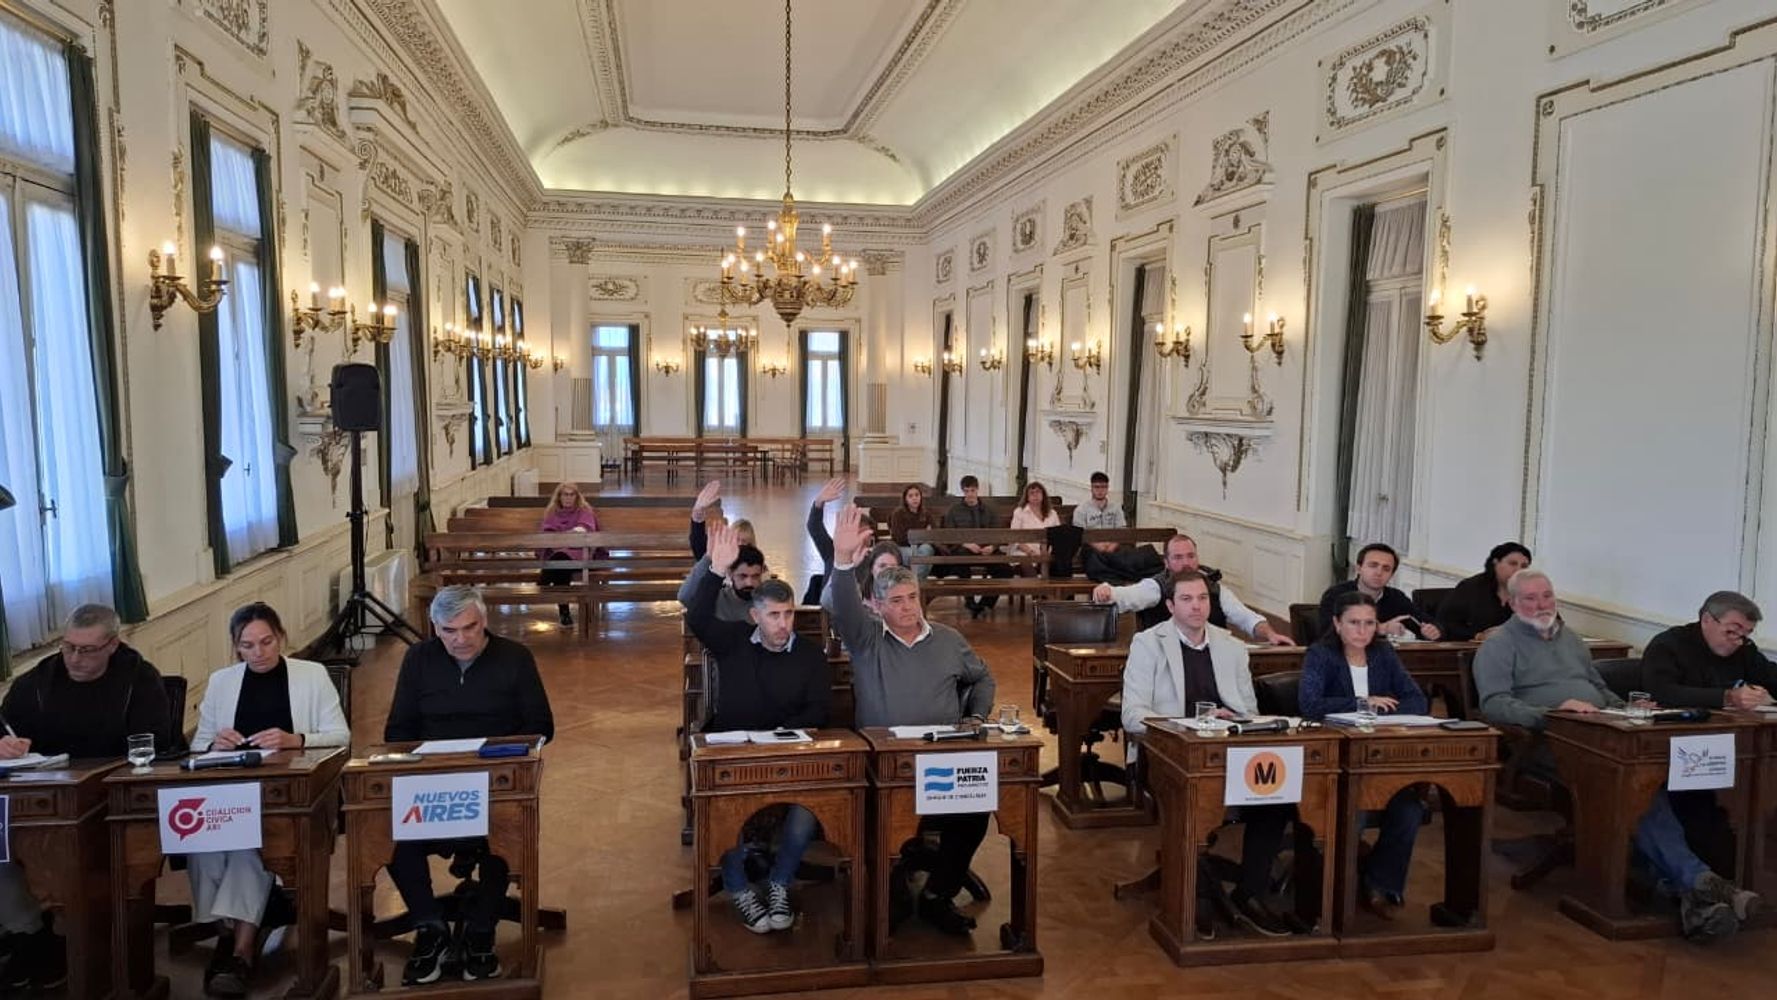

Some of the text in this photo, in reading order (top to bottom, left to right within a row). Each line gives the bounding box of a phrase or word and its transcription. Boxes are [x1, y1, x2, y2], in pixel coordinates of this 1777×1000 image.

[956, 767, 989, 775] FUERZA
[1254, 762, 1277, 785] M
[413, 790, 480, 804] NUEVOS
[401, 802, 480, 823] AIRES
